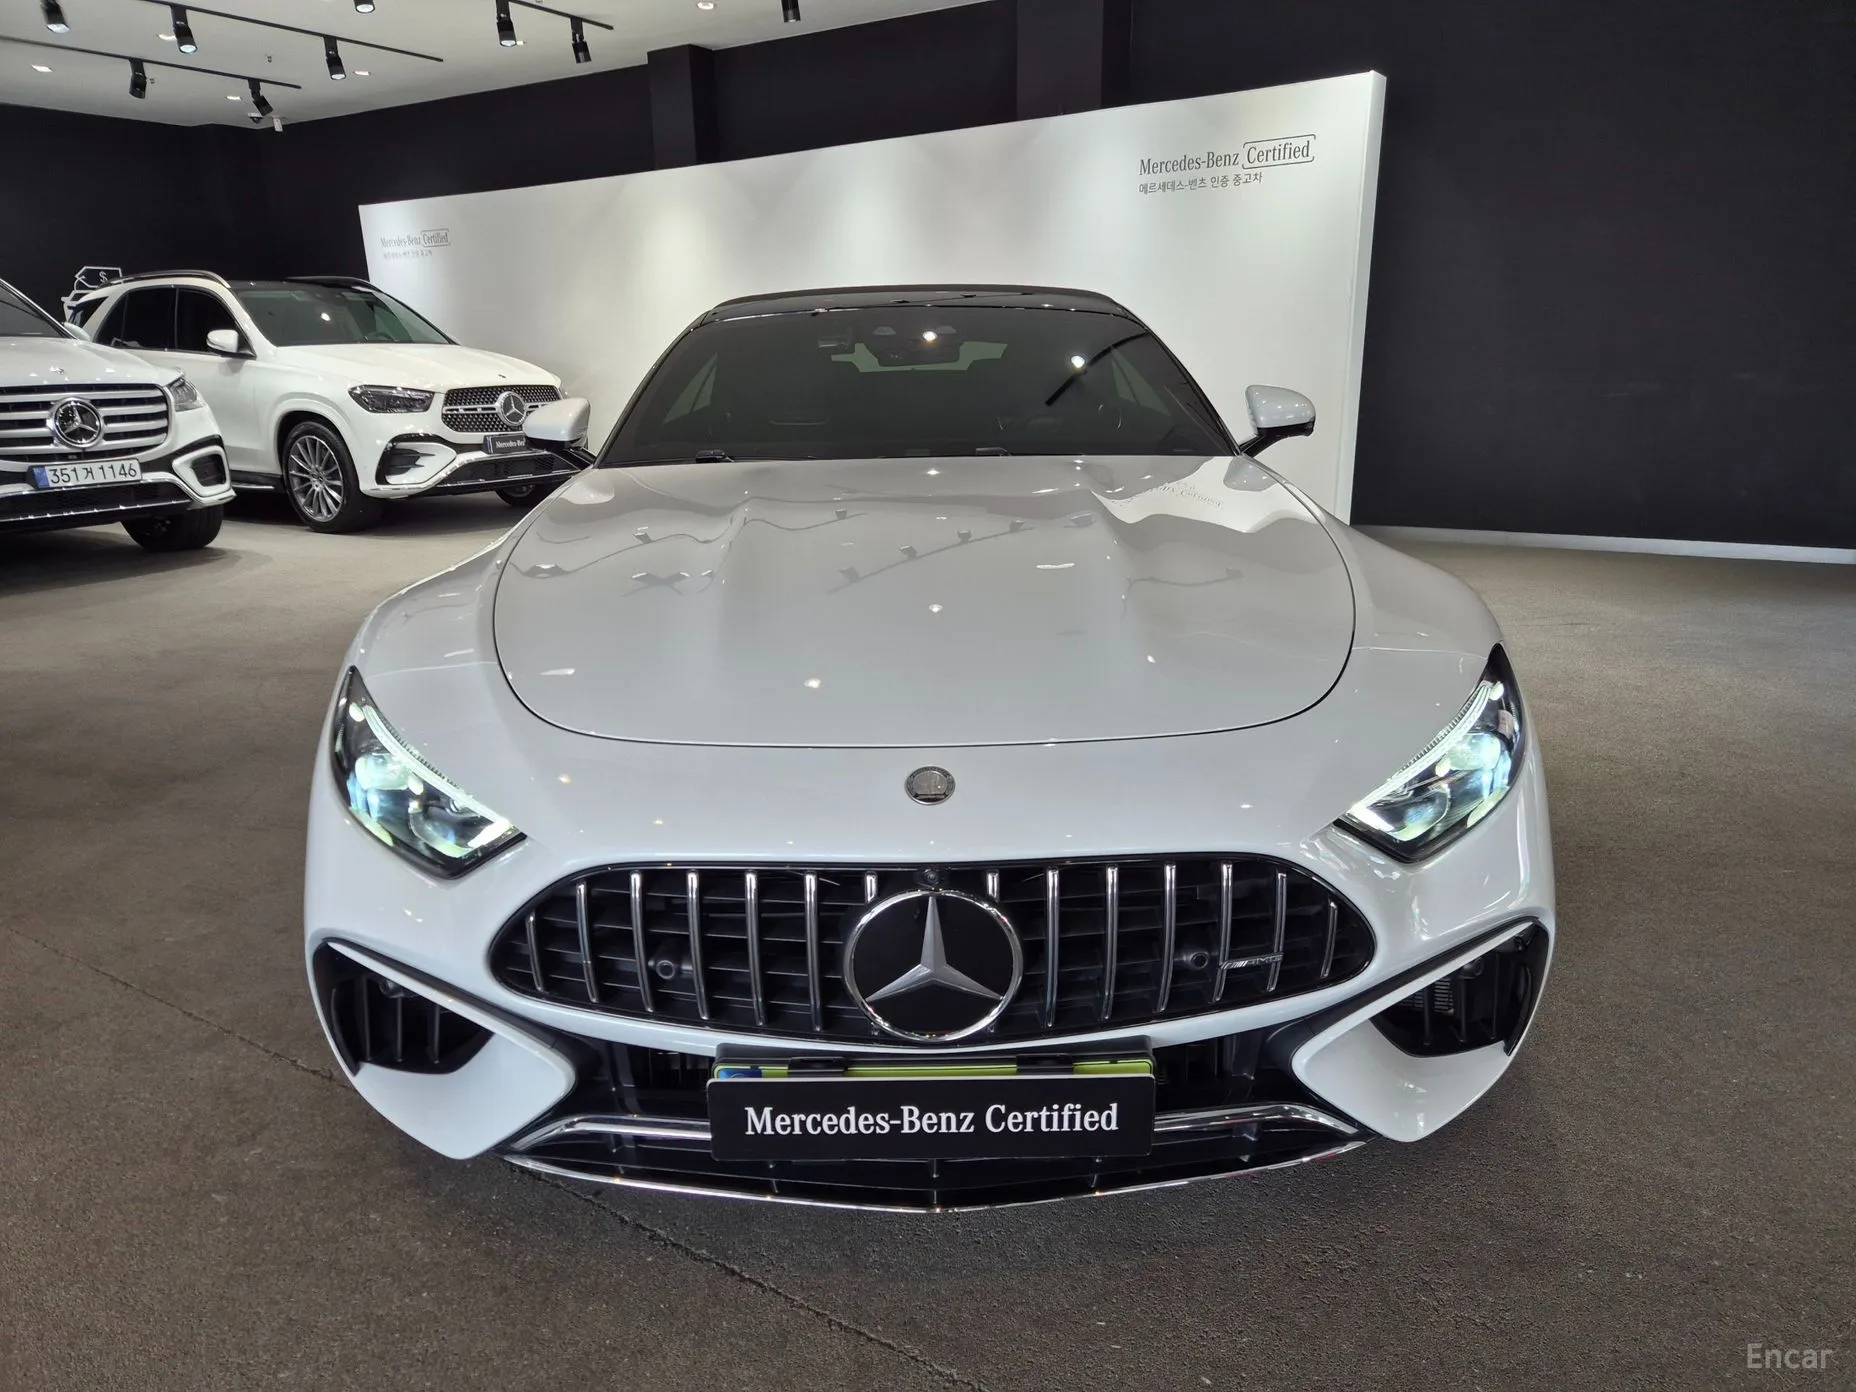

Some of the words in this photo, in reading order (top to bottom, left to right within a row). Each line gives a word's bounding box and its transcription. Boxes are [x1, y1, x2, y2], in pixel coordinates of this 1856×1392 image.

[1139, 151, 1239, 175] Mercedes-Benz
[1246, 140, 1310, 164] Certified
[1139, 177, 1206, 195] 메르세데스-벤츠
[1210, 175, 1229, 188] 인증
[1233, 172, 1263, 187] 중고차
[98, 462, 137, 480] 1146
[744, 1105, 975, 1135] Mercedes-Benz
[985, 1102, 1119, 1132] Certified
